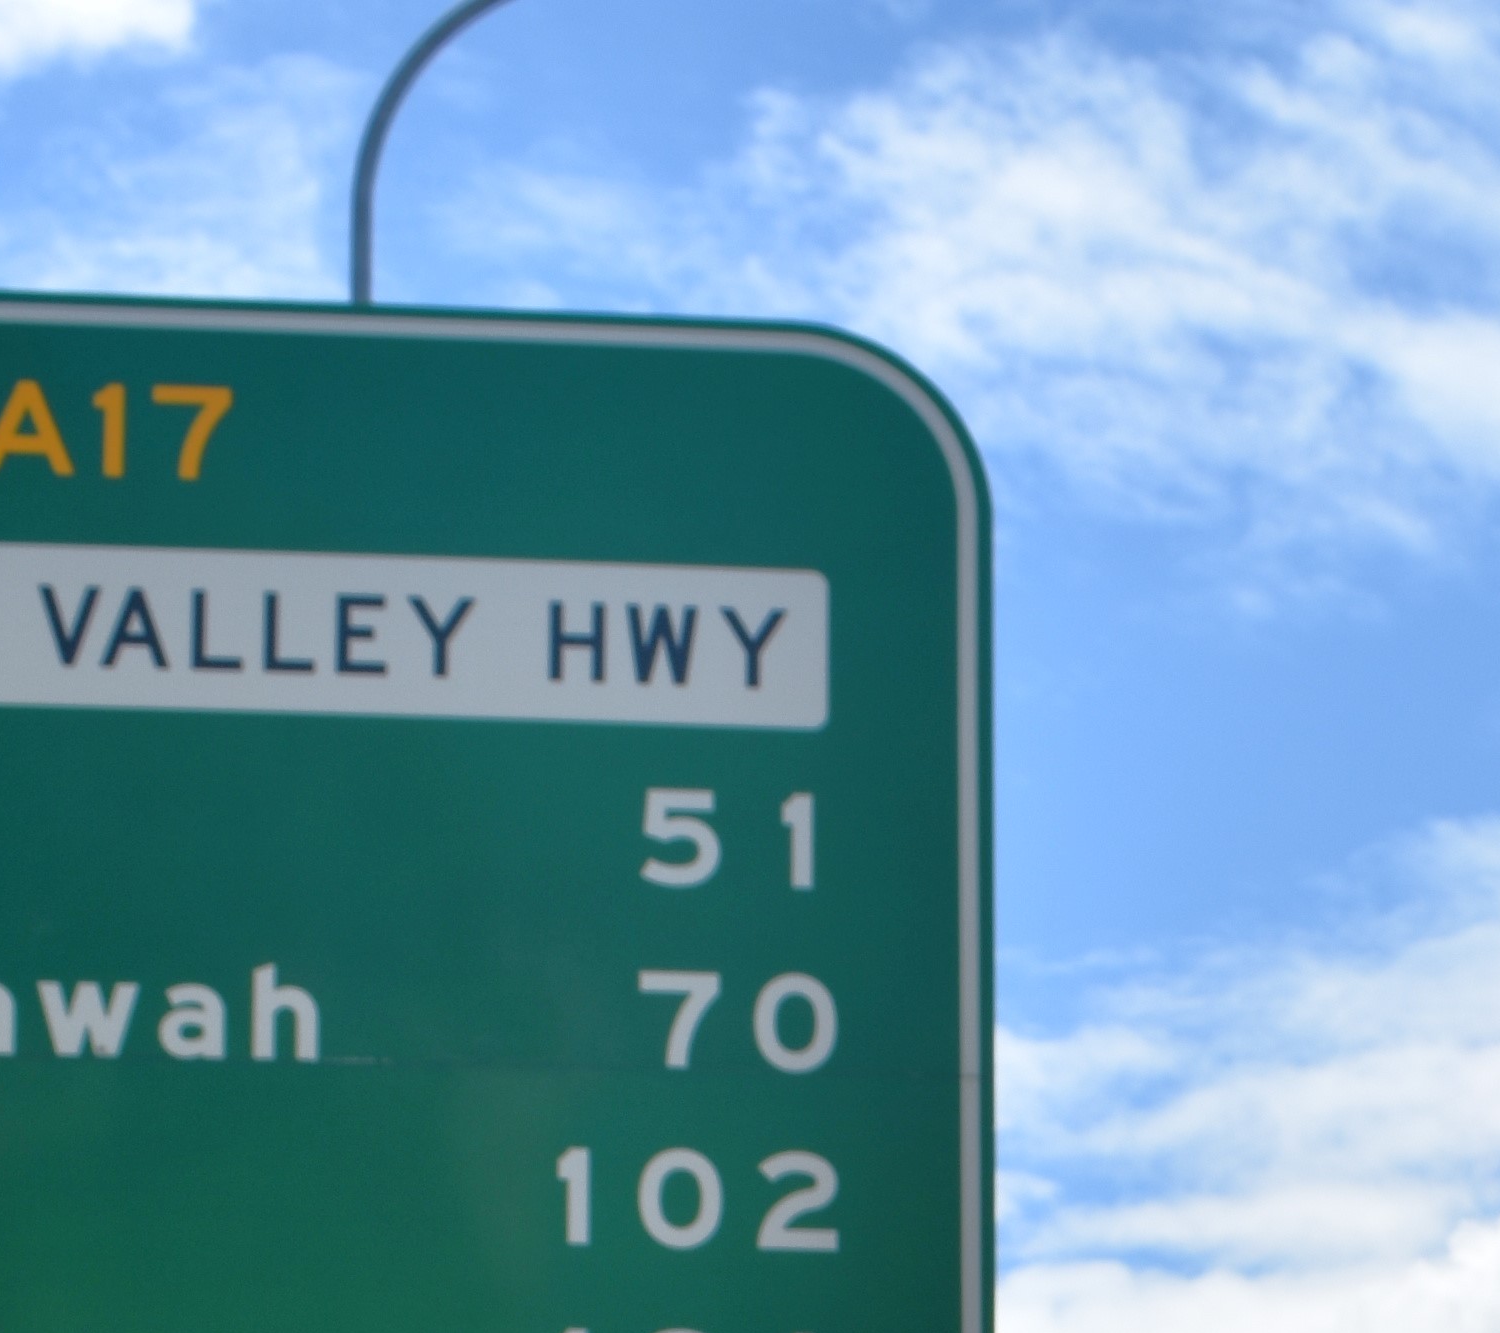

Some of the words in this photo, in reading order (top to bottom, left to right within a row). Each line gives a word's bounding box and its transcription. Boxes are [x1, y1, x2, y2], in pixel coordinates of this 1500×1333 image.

[37, 582, 475, 678] VALLEY
[547, 599, 786, 689] HWY
[639, 786, 815, 890] 51
[636, 968, 838, 1074] 70
[555, 1145, 839, 1252] 102
